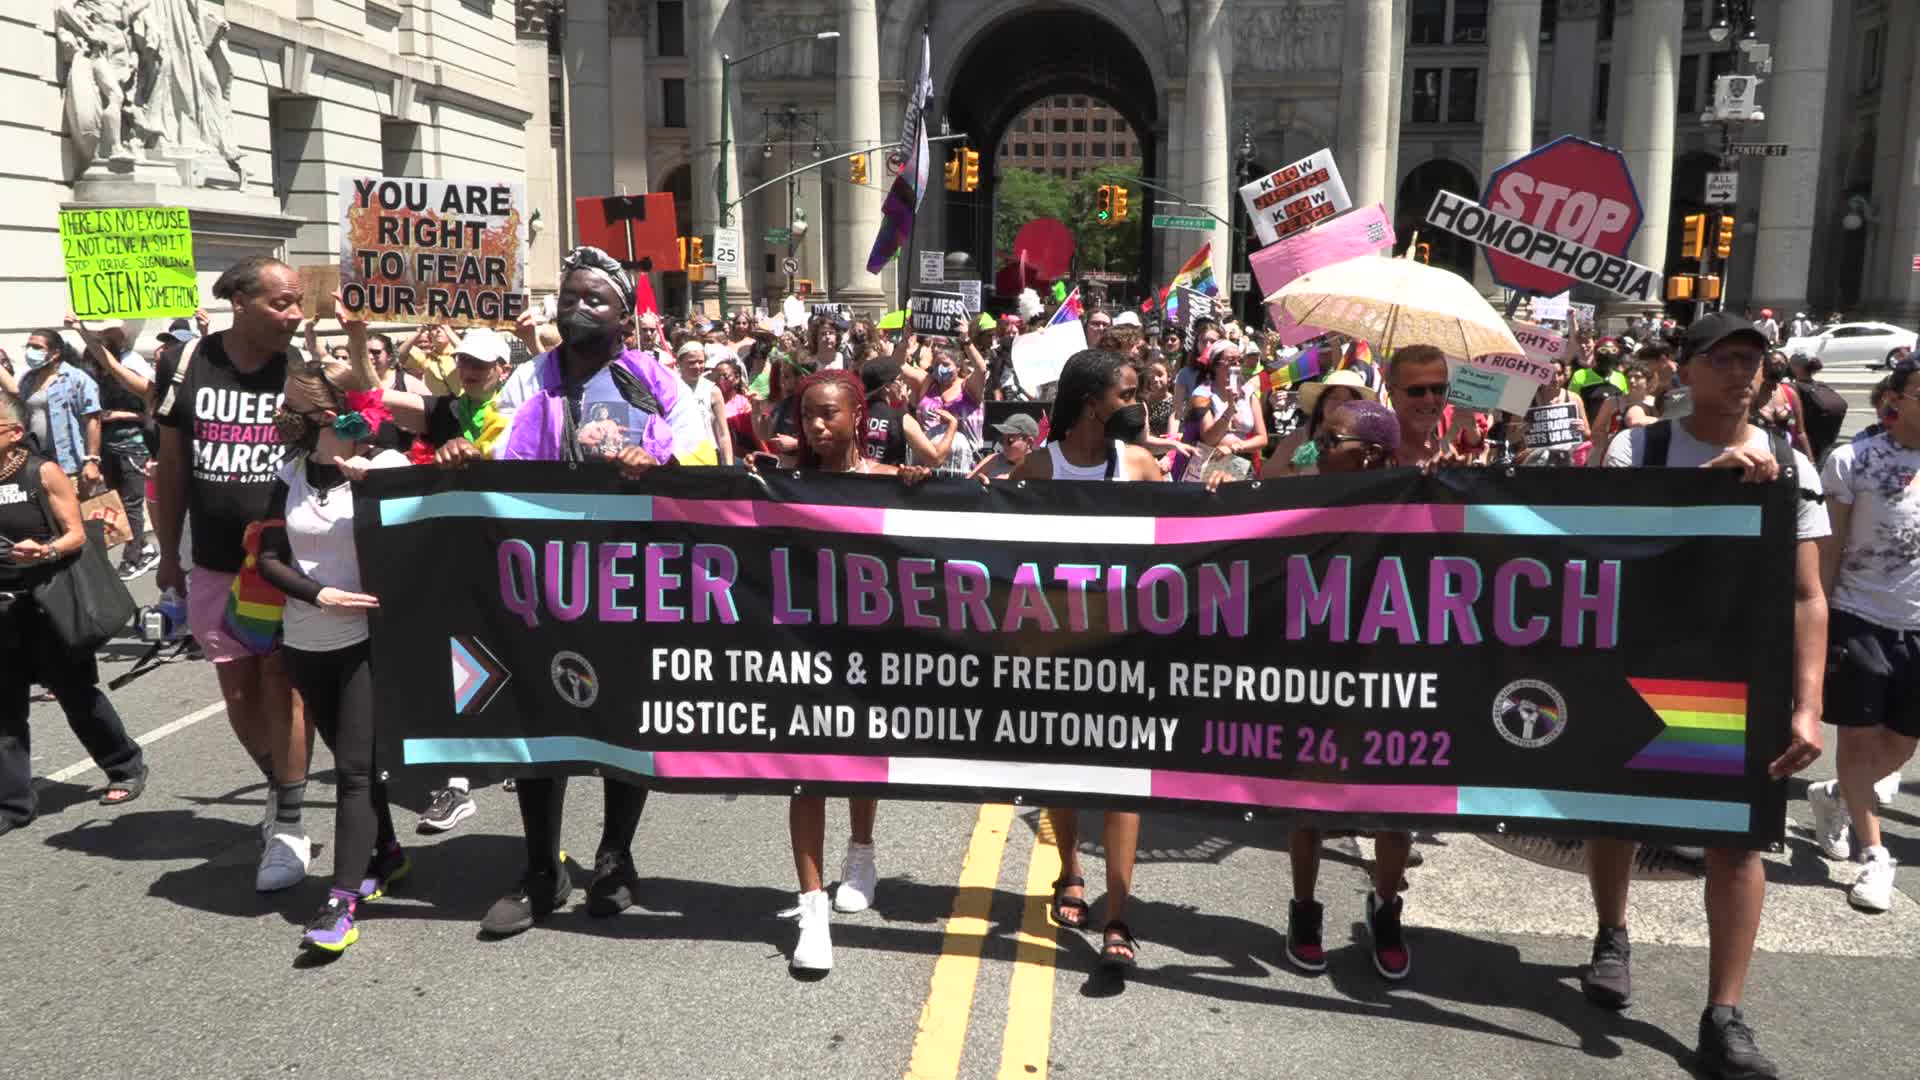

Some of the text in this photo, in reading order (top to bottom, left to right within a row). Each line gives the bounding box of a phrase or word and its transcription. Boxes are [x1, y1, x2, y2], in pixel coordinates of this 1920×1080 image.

[1255, 169, 1328, 209] JUSTICE
[1712, 175, 1731, 183] ALL
[354, 179, 511, 216] YOU ARE
[1492, 172, 1631, 249] STOP
[58, 209, 188, 236] THERE IS NO EXCUSE
[378, 216, 487, 250] RIGHT
[1276, 203, 1334, 236] PEACE
[64, 234, 185, 258] 2 NOT GIVE A SHIT
[717, 247, 736, 262] 25
[1429, 193, 1651, 300] HOMOPHOBIA
[358, 250, 508, 286] TO FEAR
[69, 271, 157, 316] LISTEN DO
[144, 284, 199, 309] SOMETHING
[342, 284, 522, 320] OUR RAGE
[815, 303, 840, 314] DYKE
[932, 297, 963, 315] MESS
[936, 315, 951, 331] US
[1491, 355, 1550, 380] RIGHTS
[193, 439, 286, 473] MARCH
[498, 538, 1622, 649] QUEER LIBERATION MARCH
[652, 647, 1438, 709] FOR TRANS & BIPOC FREEDOM, REPRODUCTIVE
[638, 701, 1452, 770] JUSTICE, AND BODILY AUTONOMY JUNE 26, 2022
